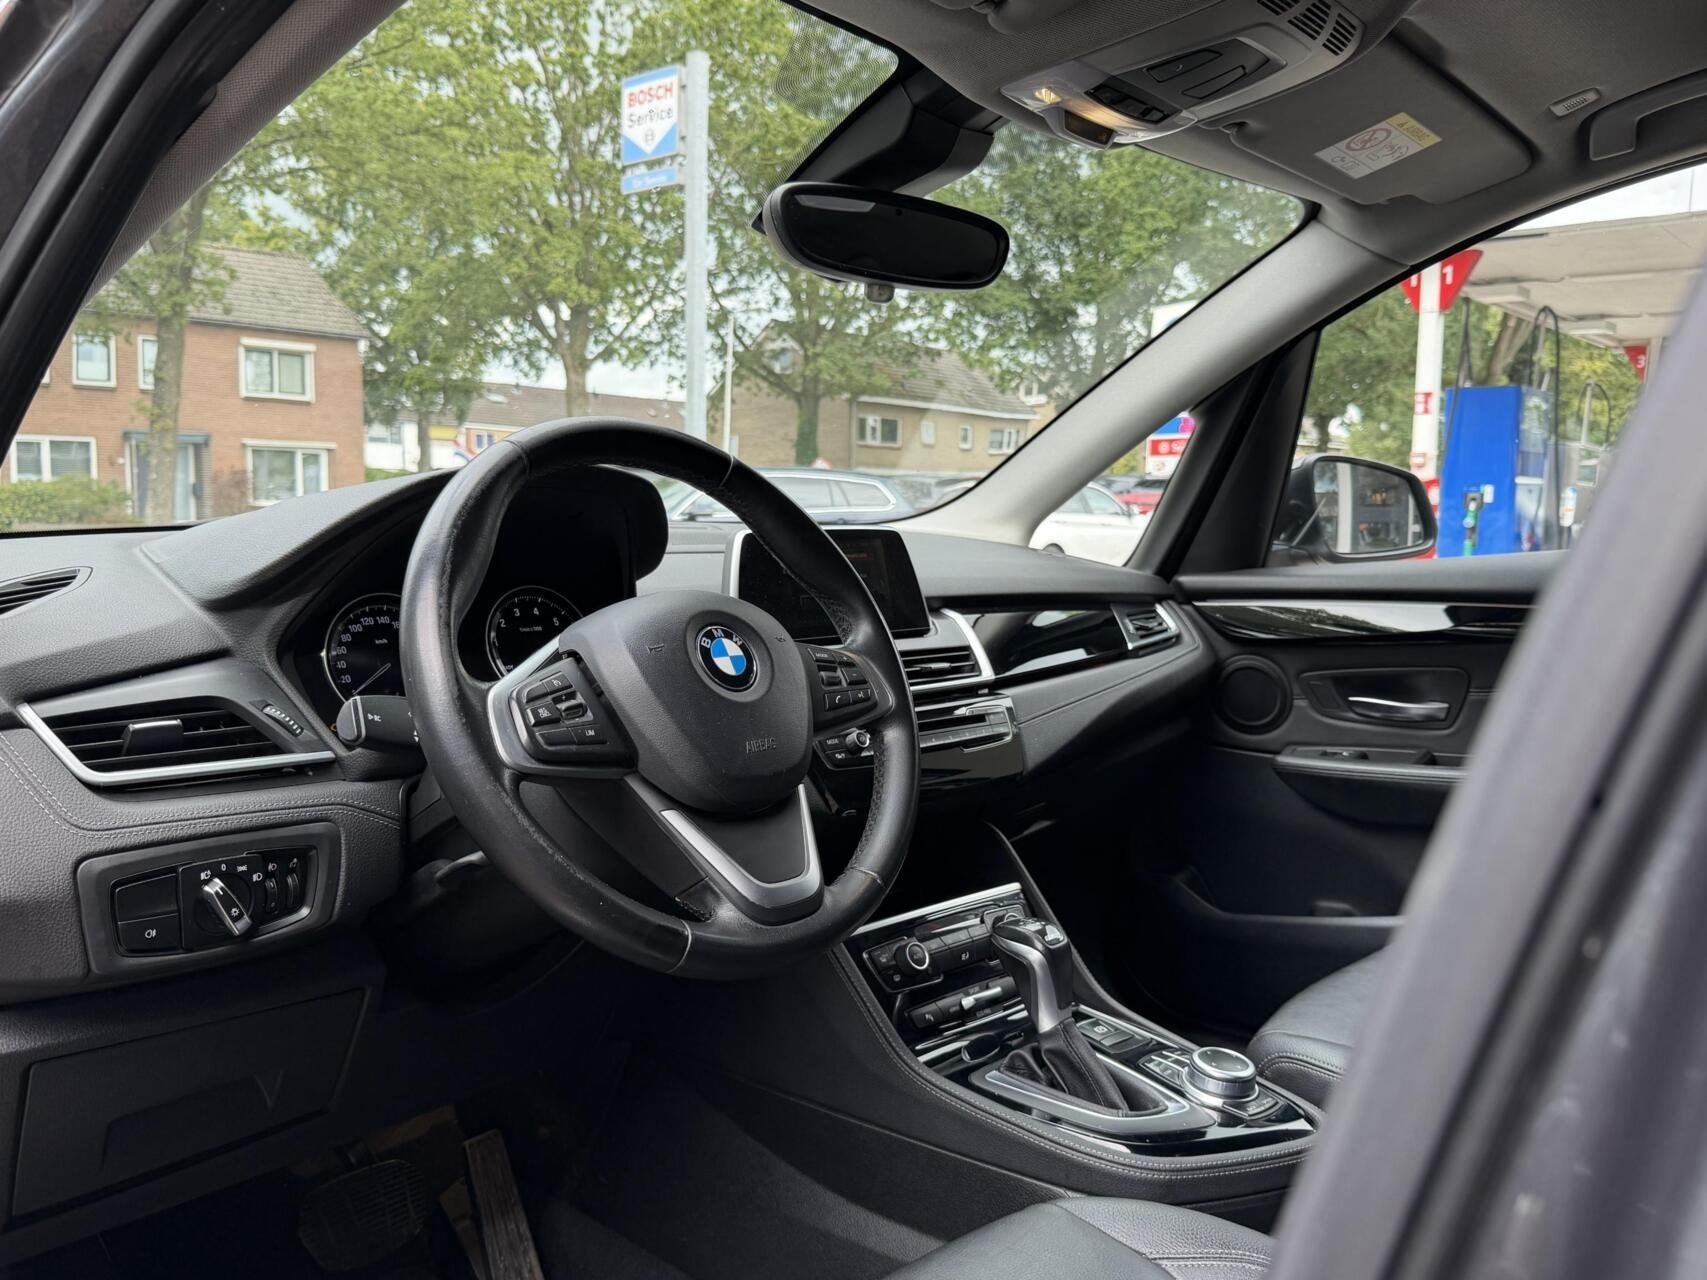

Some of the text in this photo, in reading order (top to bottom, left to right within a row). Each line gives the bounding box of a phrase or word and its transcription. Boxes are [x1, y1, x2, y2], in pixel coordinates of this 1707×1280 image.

[627, 83, 673, 107] BOSCH
[1442, 265, 1453, 285] 1
[1636, 354, 1645, 368] 3
[514, 608, 520, 616] 3
[533, 608, 539, 616] 4
[360, 617, 374, 625] 120
[376, 616, 390, 624] 140
[499, 619, 506, 627] 2
[553, 617, 559, 626] 5
[348, 624, 363, 632] 100
[340, 634, 352, 642] 80
[700, 628, 743, 648] BMW
[336, 646, 347, 654] 60
[339, 674, 352, 683] 20
